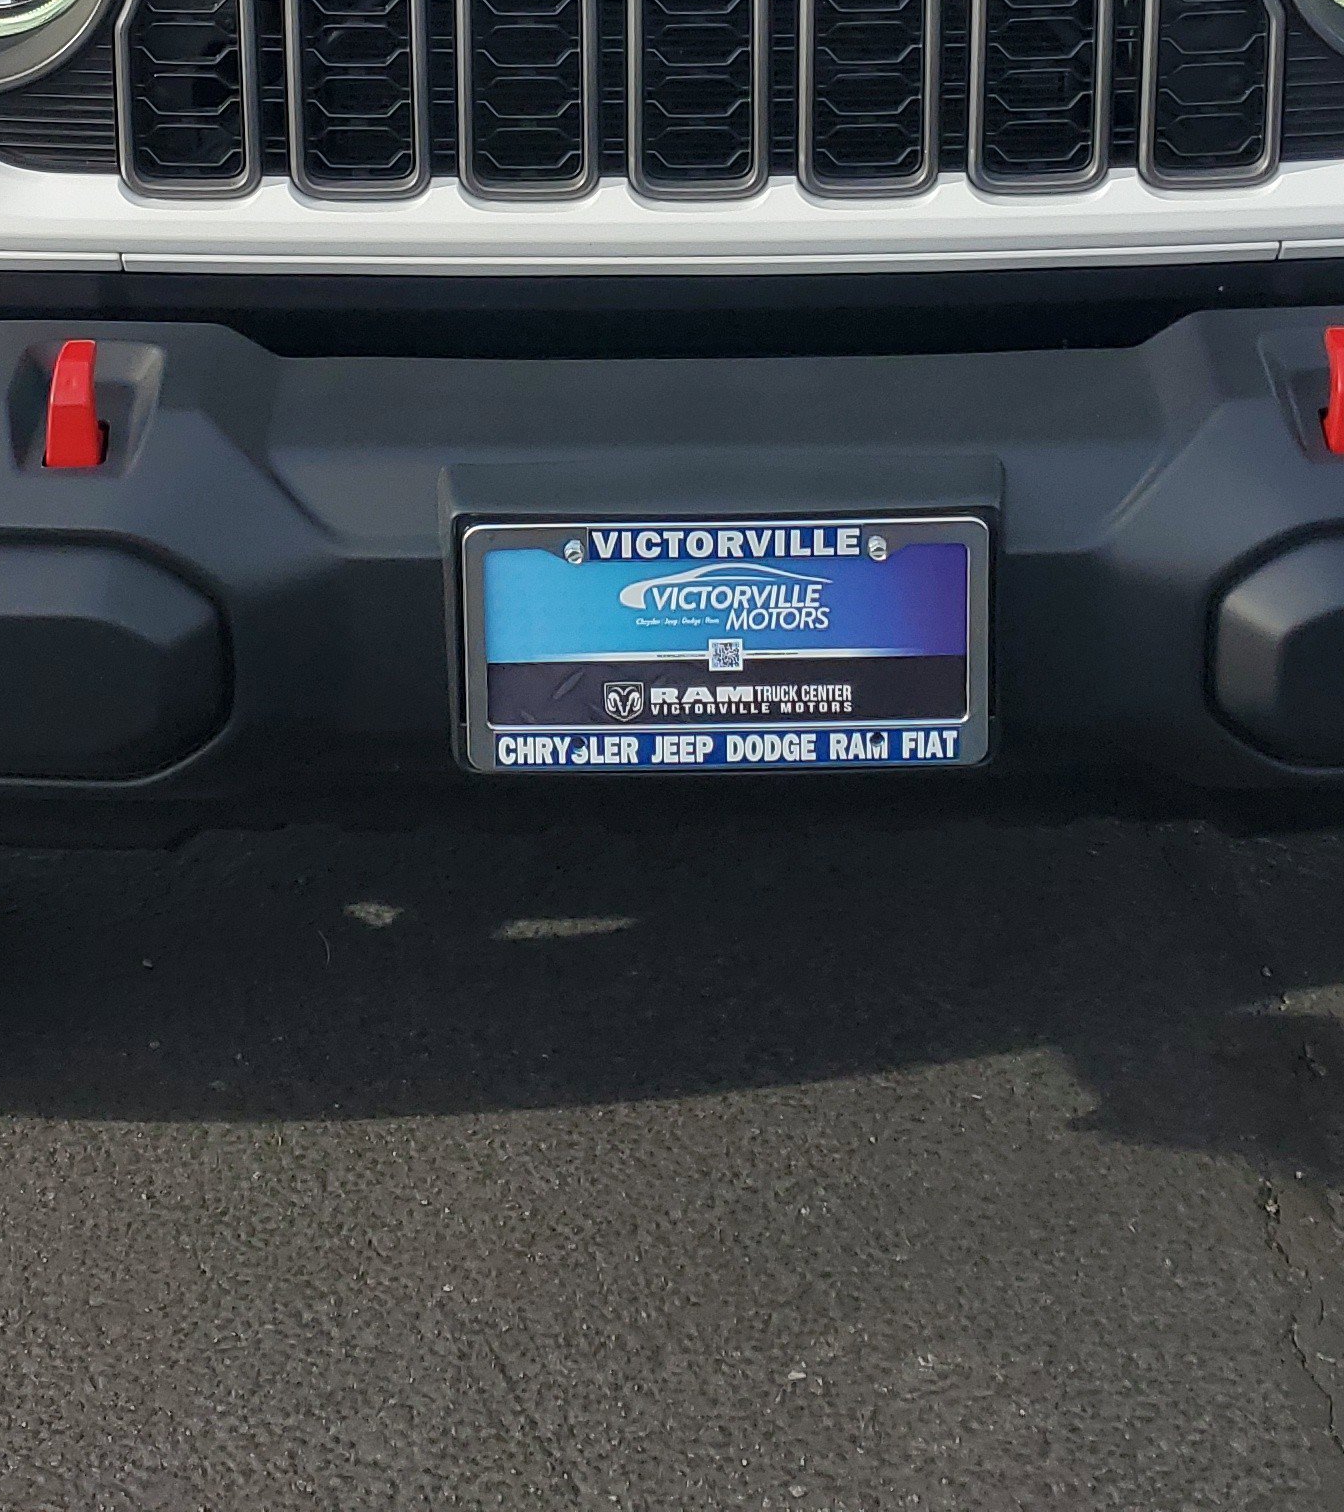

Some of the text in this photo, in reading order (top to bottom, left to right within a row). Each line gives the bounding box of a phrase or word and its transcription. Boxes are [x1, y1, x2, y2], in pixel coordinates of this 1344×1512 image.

[591, 527, 861, 559] VICTORVILLE
[651, 584, 823, 611] VICTORVILLE
[725, 607, 830, 631] MOTORS
[650, 684, 852, 703] RAM TRUCK CENTER
[650, 701, 853, 716] VICTORVILLE MOTORS
[651, 735, 714, 764] JEEP
[726, 733, 817, 763] DODGE
[829, 732, 889, 761] RAM
[901, 731, 958, 759] FIAT
